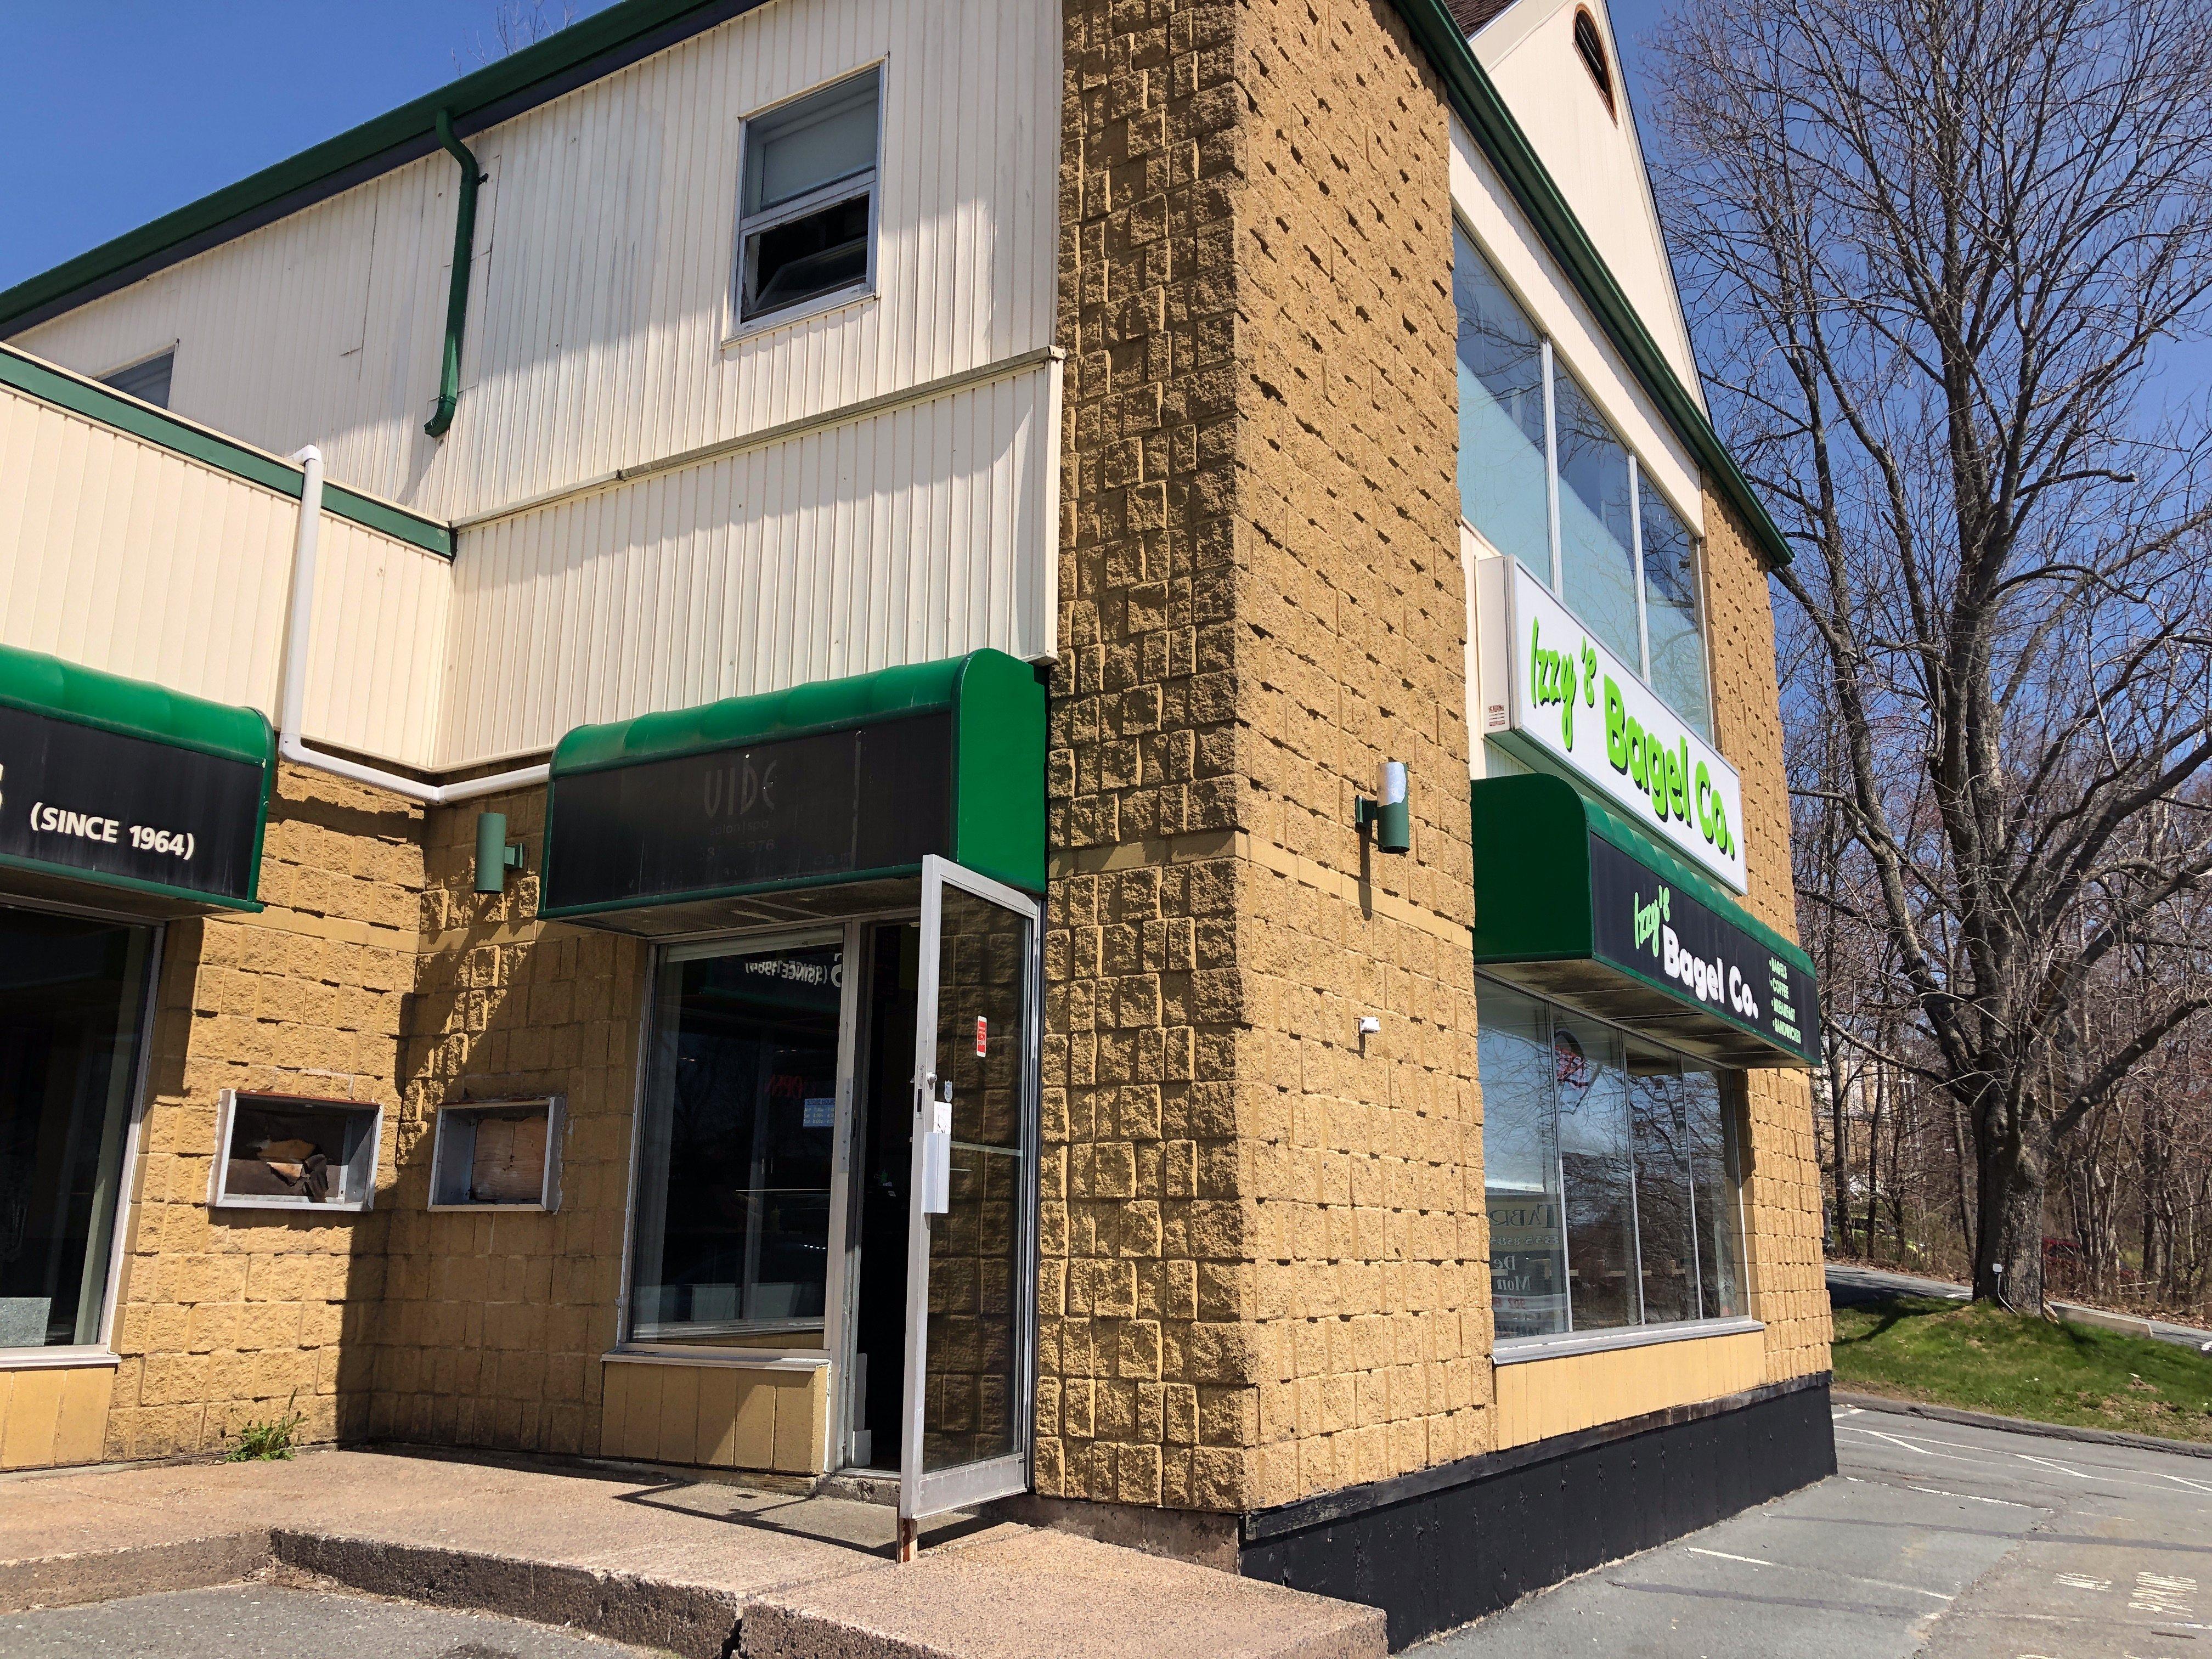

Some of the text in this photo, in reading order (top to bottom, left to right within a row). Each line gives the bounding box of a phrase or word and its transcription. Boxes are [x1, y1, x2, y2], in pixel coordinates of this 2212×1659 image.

[1530, 616, 1735, 861] Izzy's Bagel Co.
[30, 802, 195, 860] (SINCE 1964)
[1634, 885, 1670, 957] Izzy's
[1663, 924, 1758, 1019] Bagel Co.
